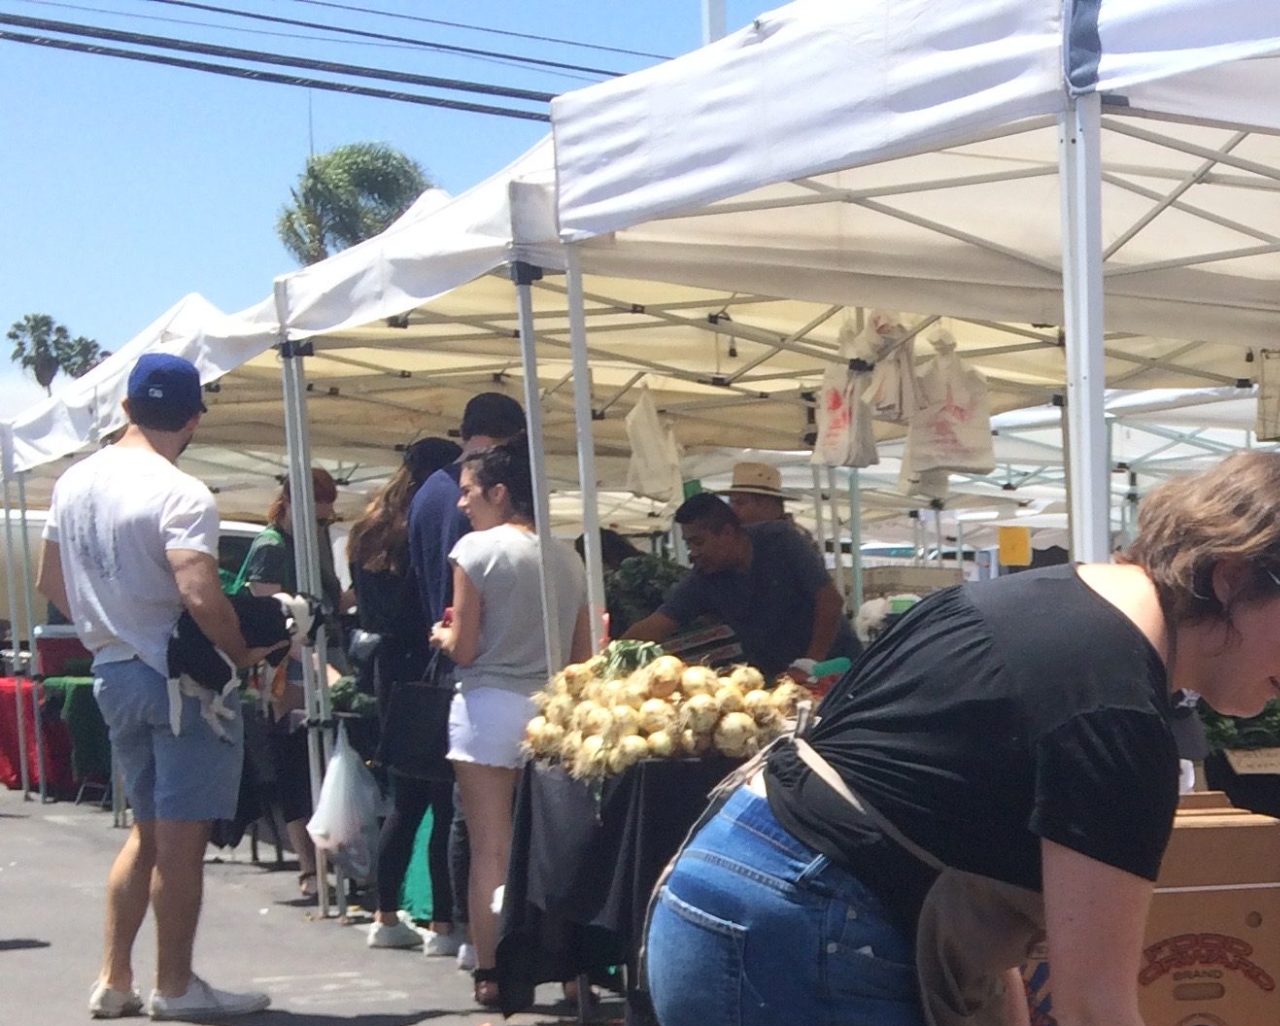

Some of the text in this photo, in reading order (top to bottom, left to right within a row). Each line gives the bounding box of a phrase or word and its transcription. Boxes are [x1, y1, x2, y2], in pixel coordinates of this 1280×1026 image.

[1143, 933, 1254, 964] FOOD
[1138, 949, 1276, 992] ORWARD
[1173, 969, 1223, 981] BRAND
